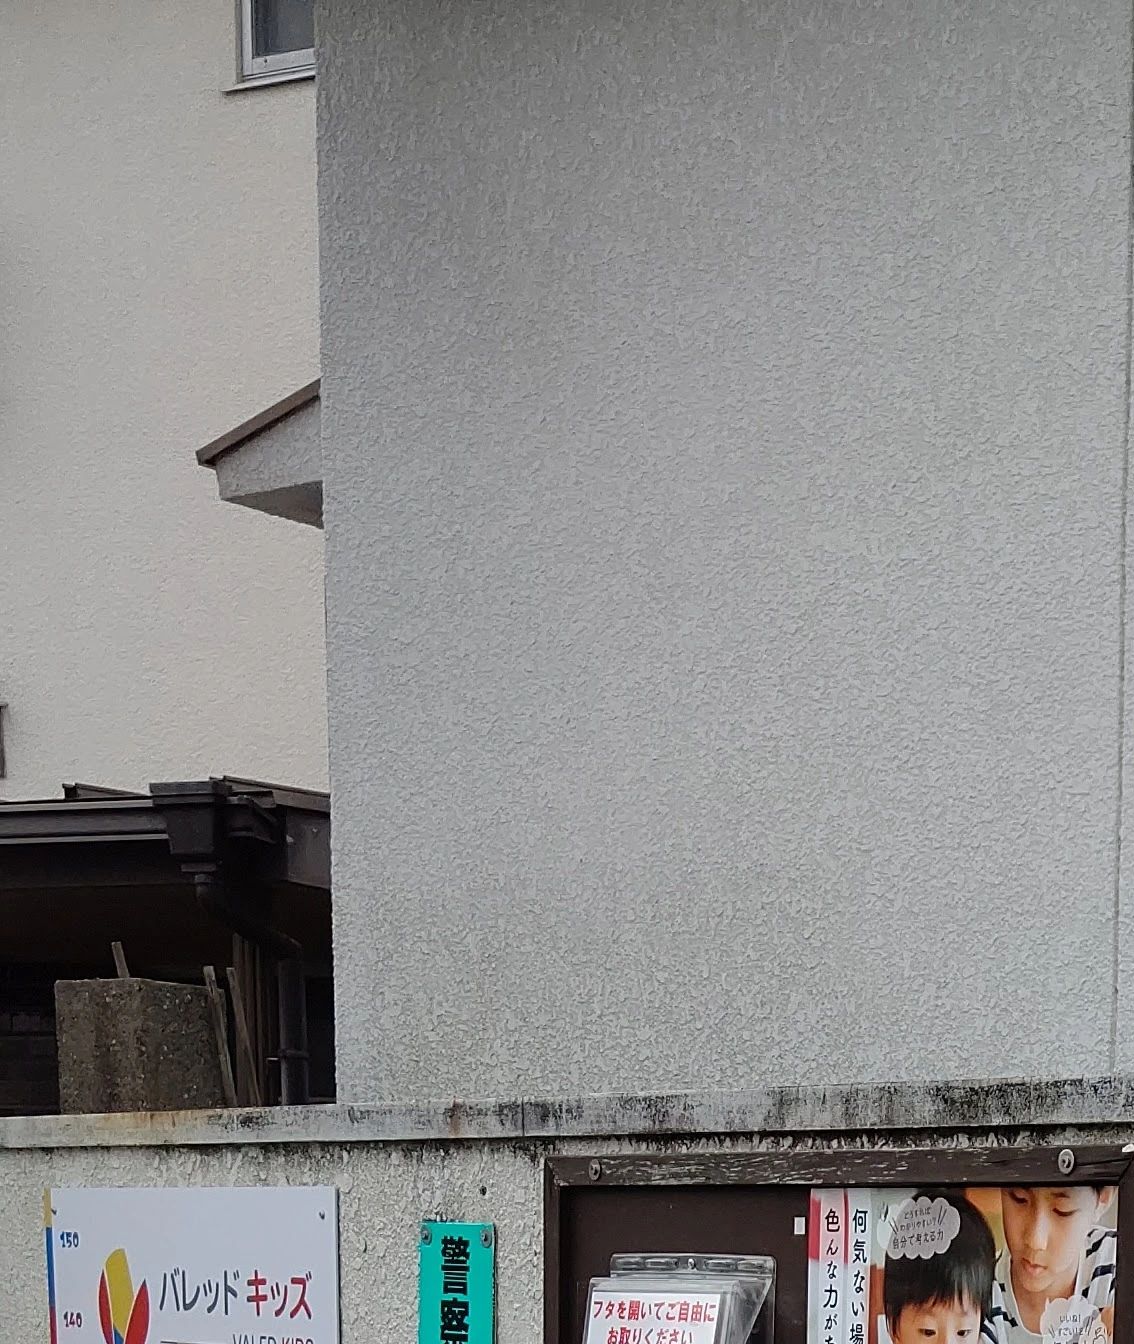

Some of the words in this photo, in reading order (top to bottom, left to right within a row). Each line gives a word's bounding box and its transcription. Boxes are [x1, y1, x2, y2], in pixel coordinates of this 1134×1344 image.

[59, 1231, 80, 1248] 150
[892, 1228, 944, 1250] 自分で考える力
[63, 1311, 83, 1328] 140
[592, 1299, 718, 1323] フタを開いてご自由に
